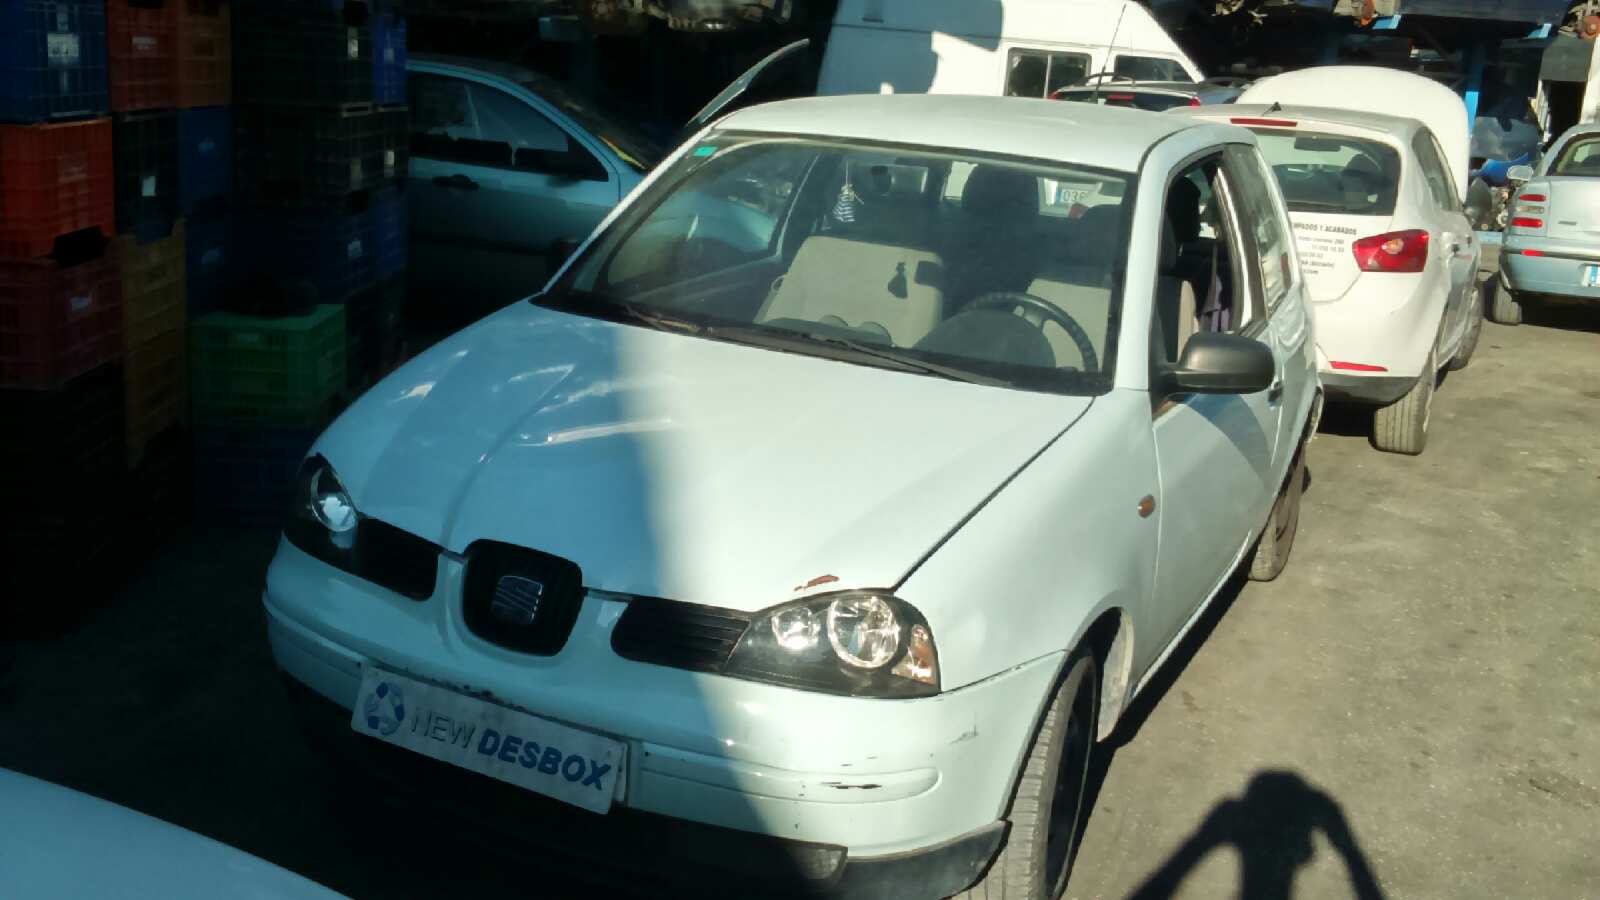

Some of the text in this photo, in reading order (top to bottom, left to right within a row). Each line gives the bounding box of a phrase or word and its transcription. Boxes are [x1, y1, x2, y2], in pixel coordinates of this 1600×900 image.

[1324, 226, 1357, 235] ACABADOS
[411, 709, 611, 791] NEW DESBOX
